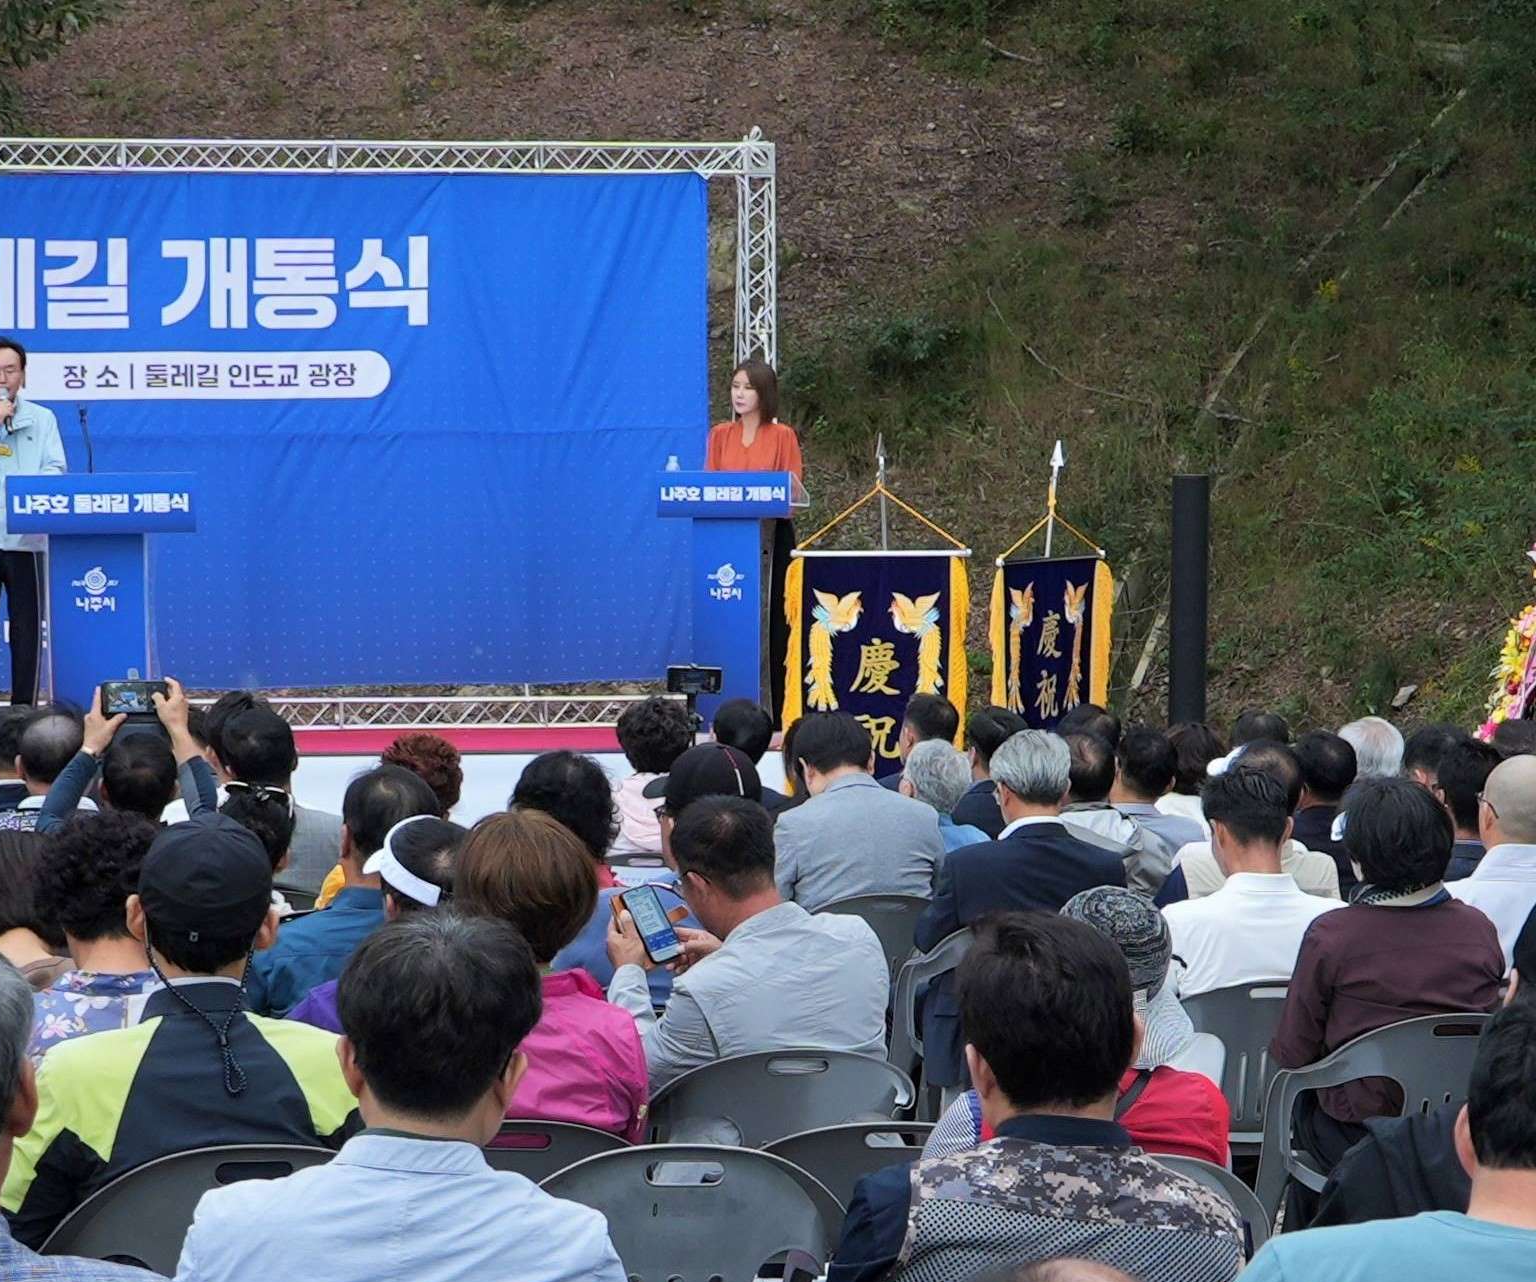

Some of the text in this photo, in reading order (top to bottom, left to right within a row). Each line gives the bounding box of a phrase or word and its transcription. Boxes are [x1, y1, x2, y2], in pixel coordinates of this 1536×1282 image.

[160, 234, 430, 330] 개통식
[62, 364, 89, 390] 장
[95, 364, 120, 389] 소
[144, 363, 220, 389] 둘레길
[227, 363, 301, 389] 인도교
[307, 363, 358, 389] 광장
[12, 492, 190, 515] 나주호 둘레길 개통식
[660, 485, 702, 502] 나주호
[75, 595, 117, 613] 나주시
[1034, 608, 1065, 722] 慶祝
